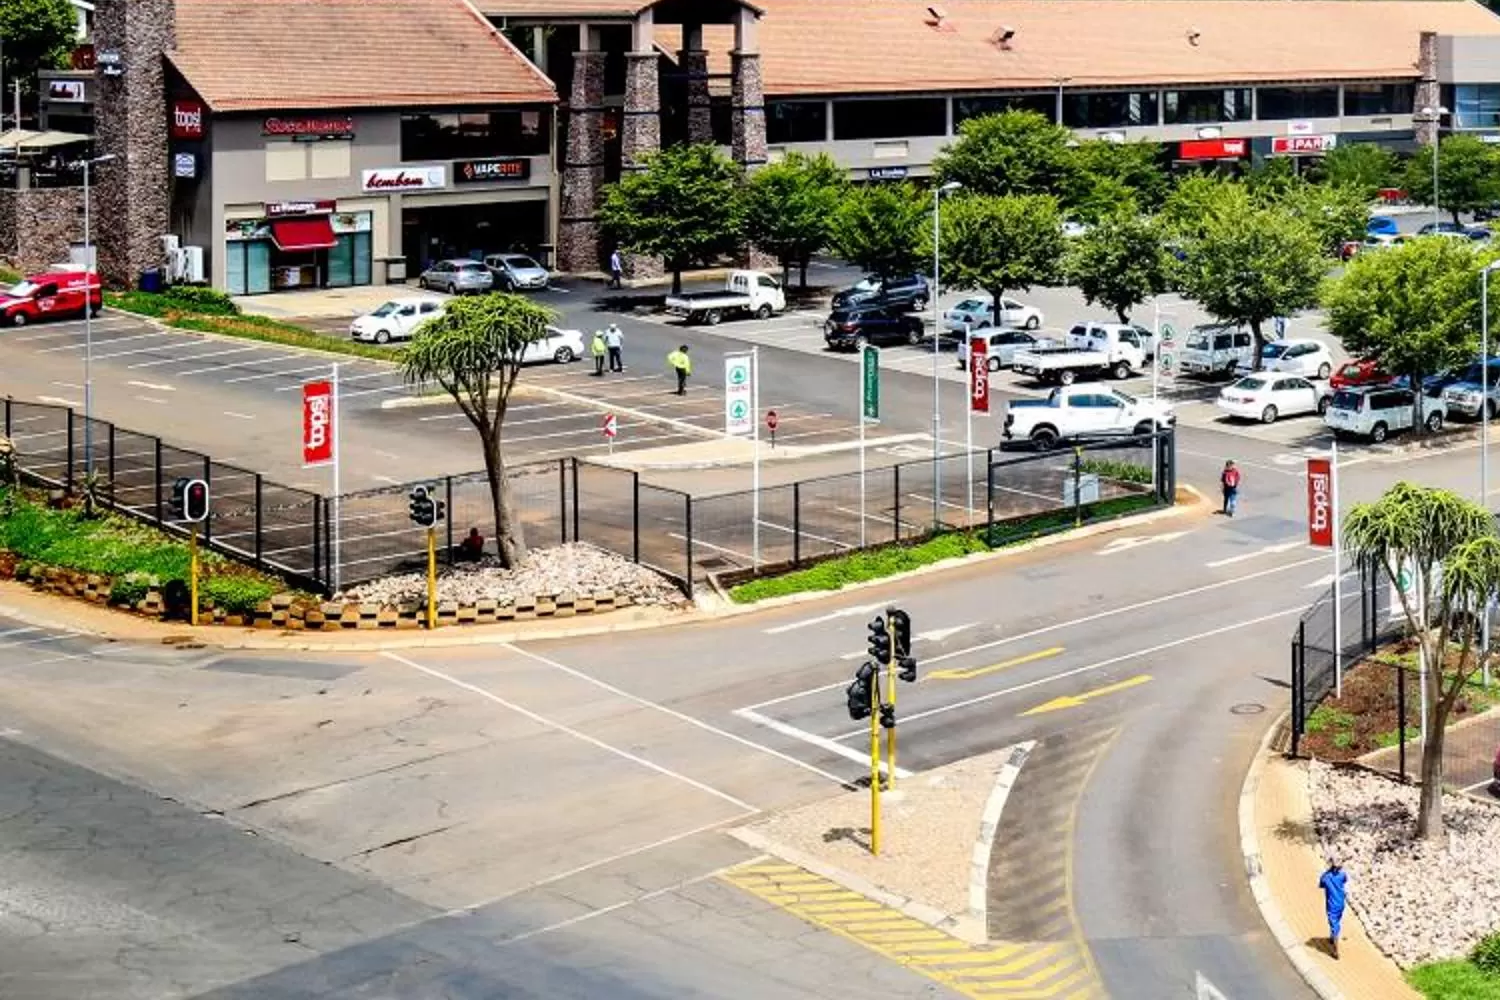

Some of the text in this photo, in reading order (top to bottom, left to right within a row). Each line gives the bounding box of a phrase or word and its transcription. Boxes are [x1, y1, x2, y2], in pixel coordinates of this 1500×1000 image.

[1286, 137, 1322, 152] SPAR
[972, 352, 987, 400] tops!
[306, 394, 329, 451] tops!
[1310, 473, 1329, 532] tops!
